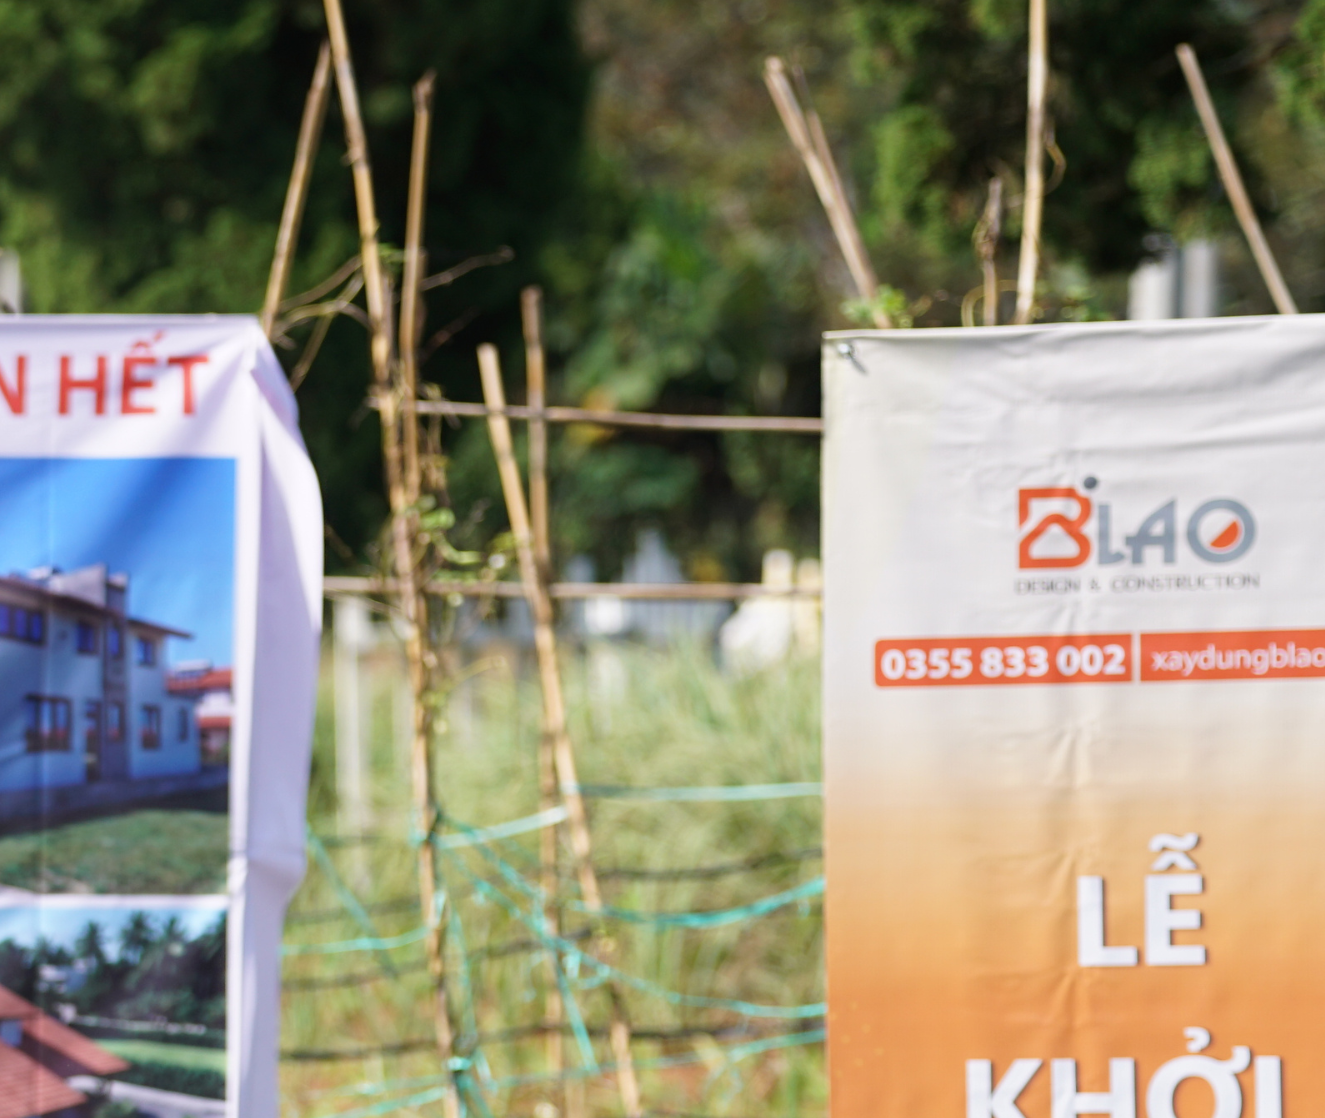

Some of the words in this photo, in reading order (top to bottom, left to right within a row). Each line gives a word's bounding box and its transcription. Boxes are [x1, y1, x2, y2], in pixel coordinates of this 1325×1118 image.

[58, 329, 210, 416] HẾT
[1015, 577, 1081, 595] DESIGN
[1110, 573, 1260, 593] CONSTRUCTION
[881, 649, 973, 680] 0355
[980, 646, 1048, 678] 833
[1056, 644, 1125, 675] 002
[1151, 641, 1325, 677] xaydungblao
[1076, 832, 1207, 967] LỄ
